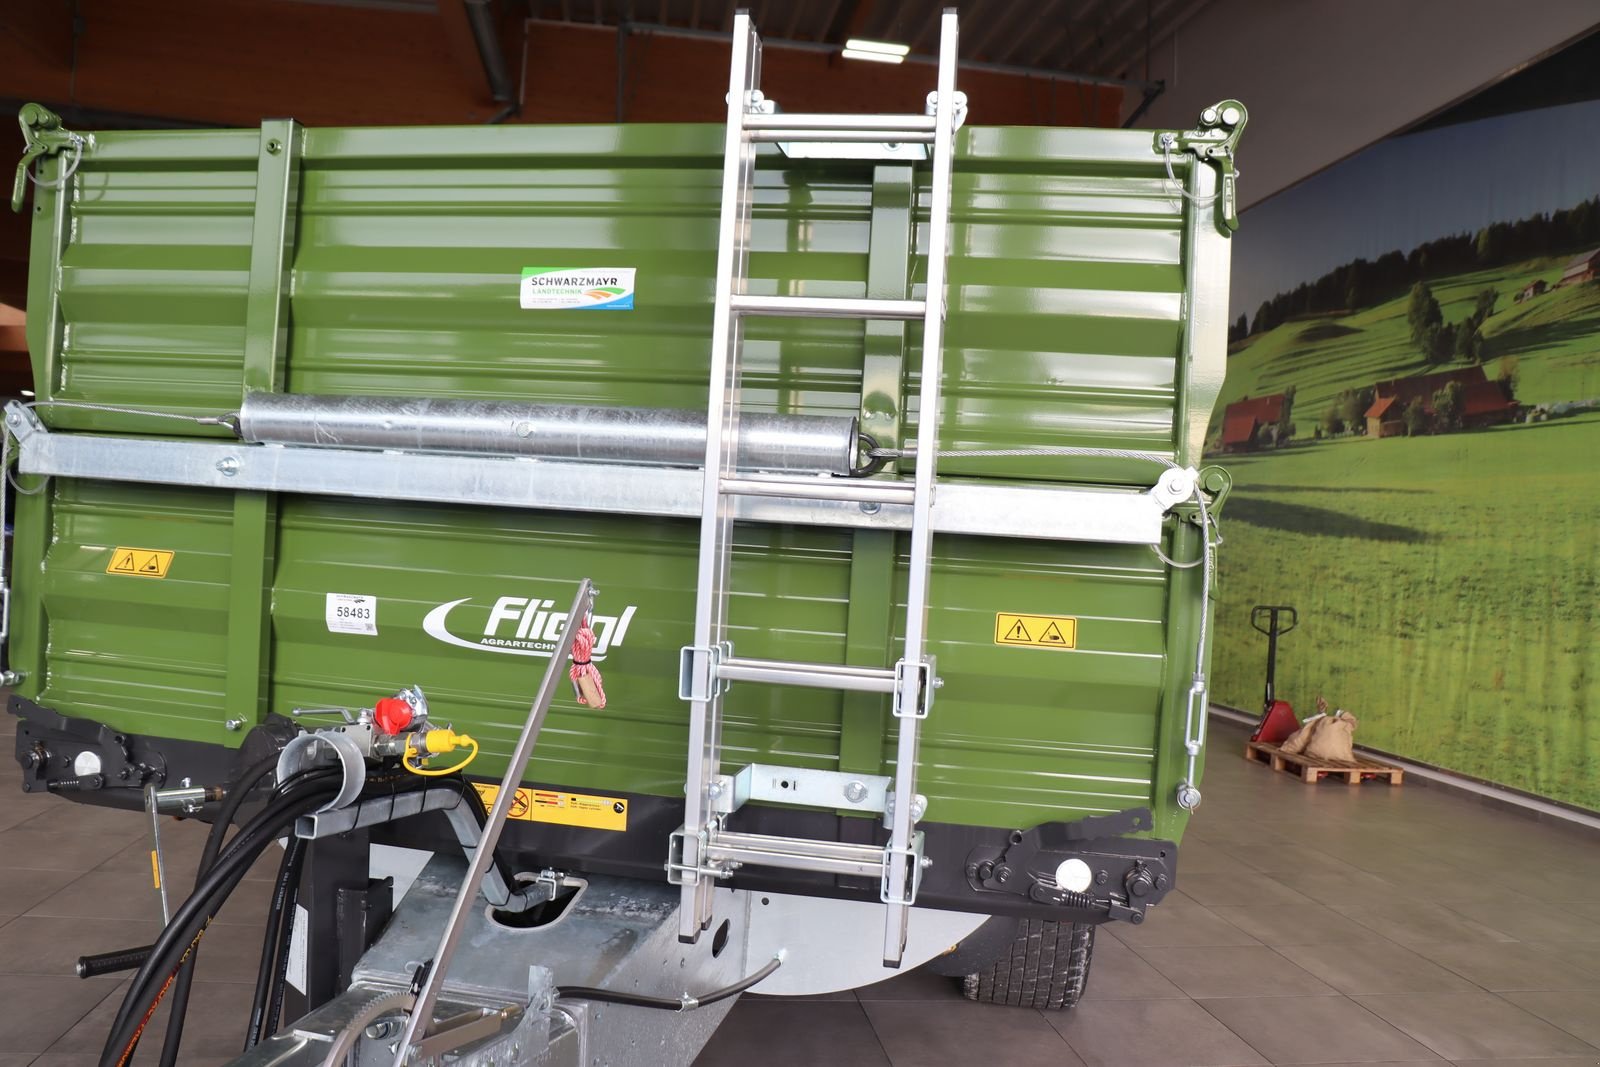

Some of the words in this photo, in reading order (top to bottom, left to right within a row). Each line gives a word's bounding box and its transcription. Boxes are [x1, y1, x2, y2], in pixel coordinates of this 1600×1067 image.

[531, 277, 618, 286] SCHWARZMAYR
[337, 606, 370, 619] 58483
[480, 638, 557, 650] AGRARTECHN
